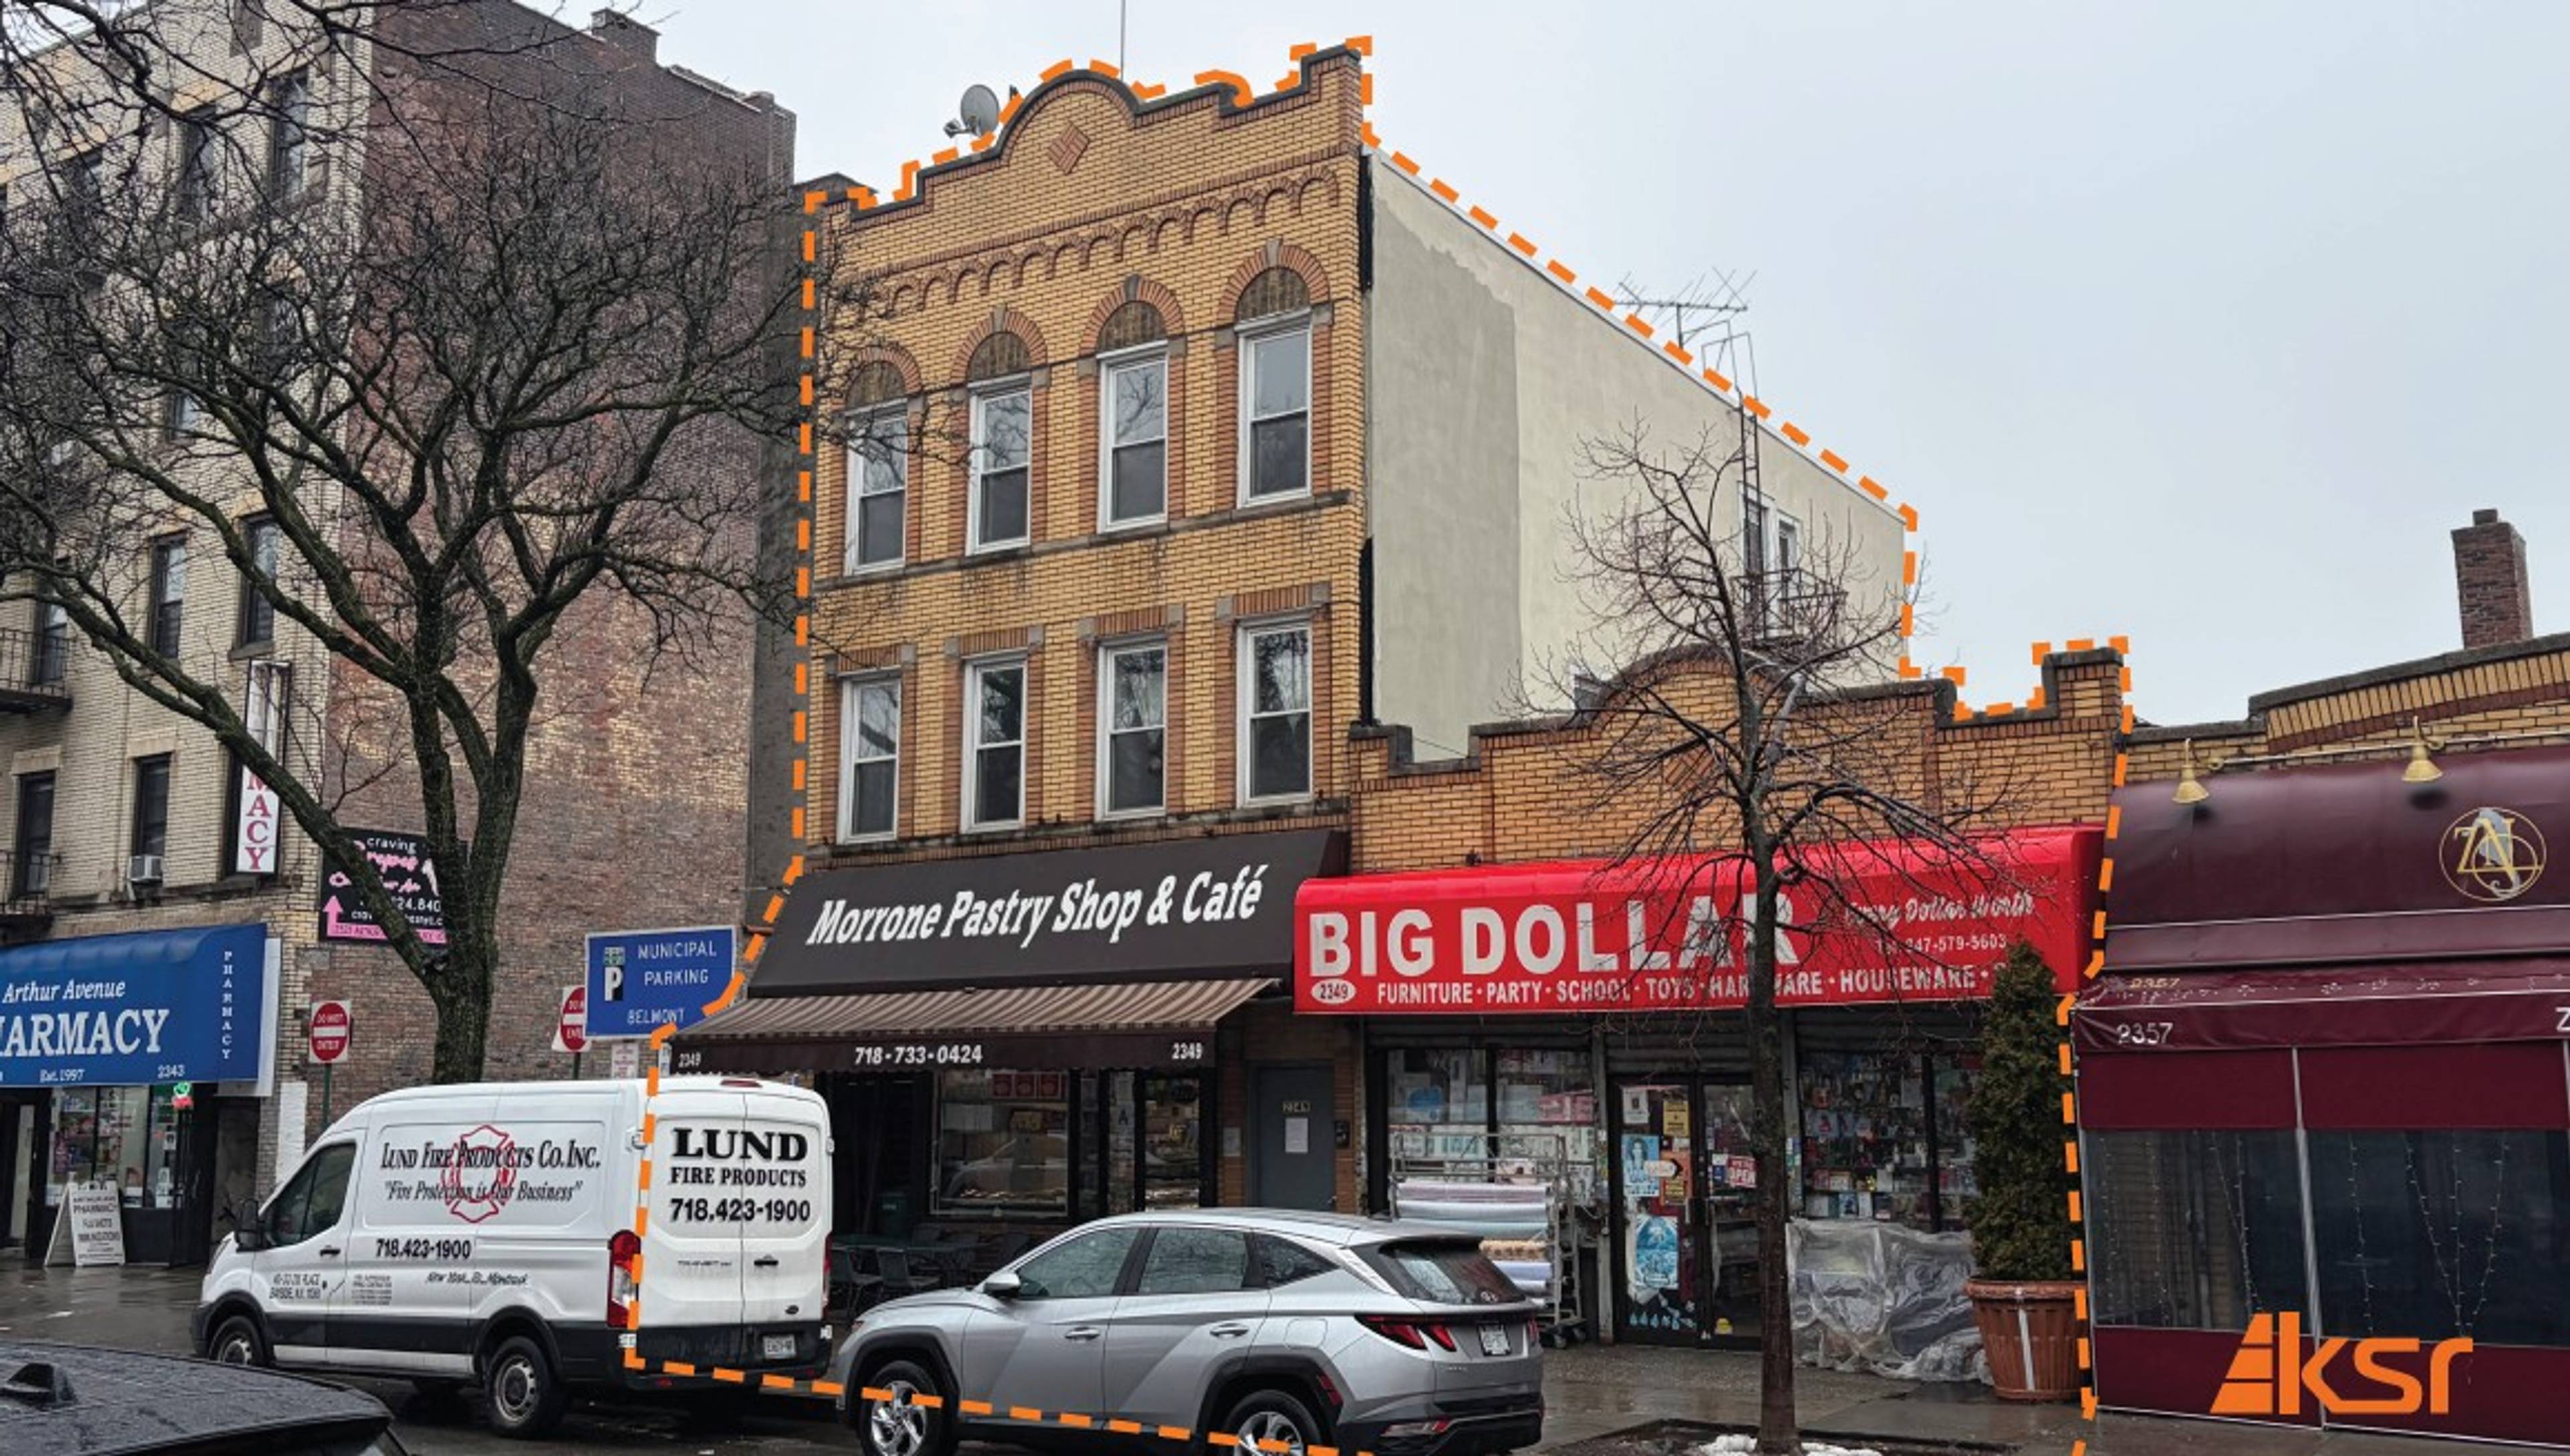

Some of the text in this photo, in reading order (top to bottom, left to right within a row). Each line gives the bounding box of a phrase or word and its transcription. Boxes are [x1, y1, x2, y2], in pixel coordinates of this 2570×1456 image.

[366, 838, 417, 854] craving
[805, 864, 1269, 949] Morrone Pastry Shop & Café
[1309, 893, 1800, 977] BIG DOLLAR
[604, 940, 717, 1002] P MUNICIPAL
[645, 968, 709, 986] PARKING
[3, 978, 126, 1004] Arthur Avenue
[1320, 983, 1349, 1000] 2349
[1377, 982, 1473, 1004] FURNITURE
[1486, 980, 1542, 1004] PARTY
[1556, 978, 1631, 1002] SCHOOL
[1645, 976, 1695, 1000] TOYS
[221, 950, 234, 1060] PHARMACY
[626, 1008, 685, 1025] BELMONT
[2116, 1022, 2173, 1044] 2357
[678, 1052, 701, 1068] 2349
[1171, 1042, 1203, 1060] 2349
[157, 1065, 185, 1079] 2343
[672, 1127, 808, 1162] LUND
[670, 1167, 806, 1187] FIRE PRODUCTS
[670, 1198, 810, 1221] 718.423-1900
[375, 1238, 471, 1259] 718.423-1900
